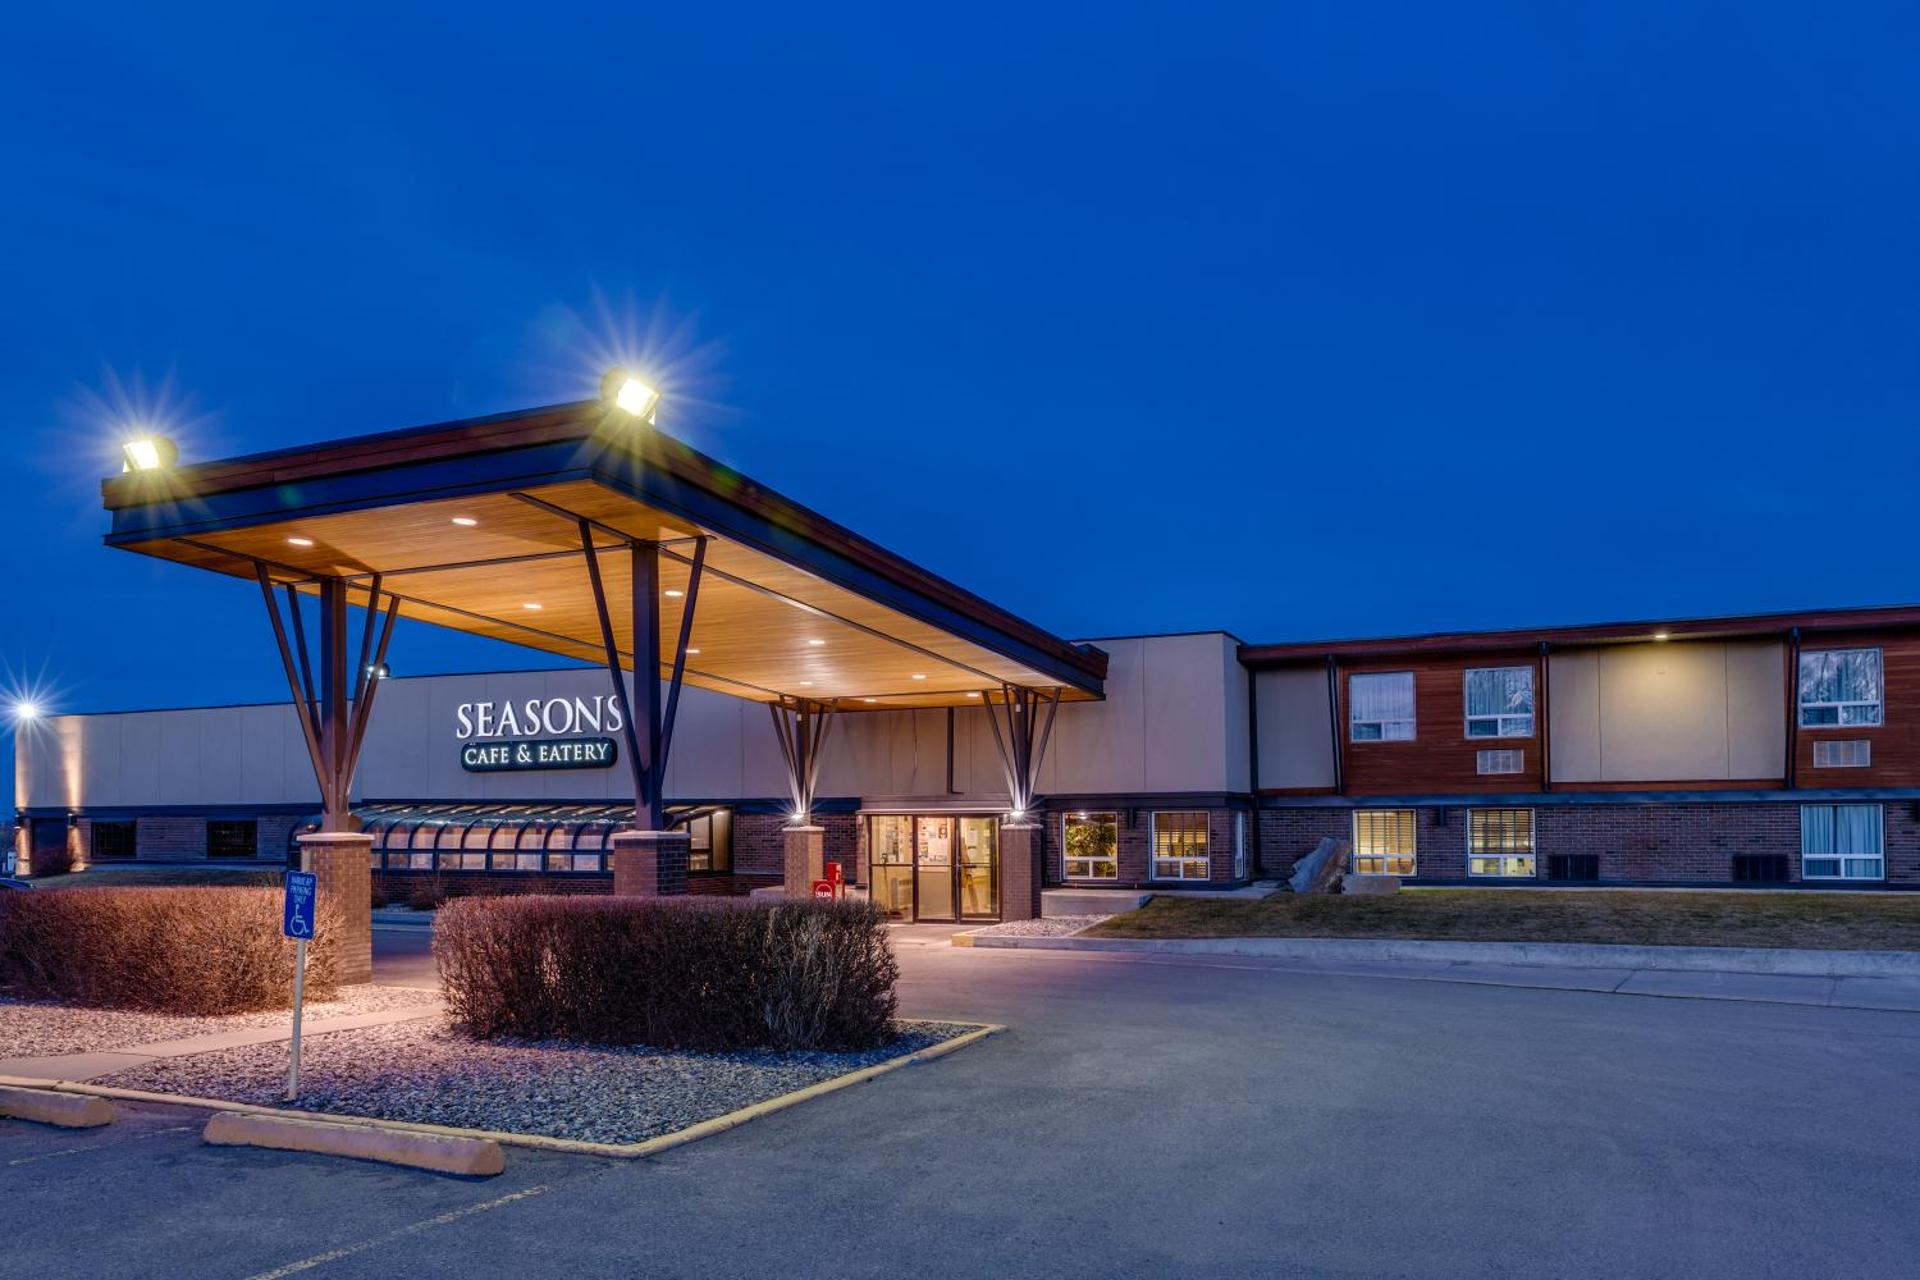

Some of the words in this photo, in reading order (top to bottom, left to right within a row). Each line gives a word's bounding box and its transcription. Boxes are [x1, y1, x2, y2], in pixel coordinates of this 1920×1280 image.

[456, 694, 623, 739] SEASONS
[464, 747, 510, 765] CAFE
[516, 744, 533, 763] &
[539, 743, 609, 763] EATERY
